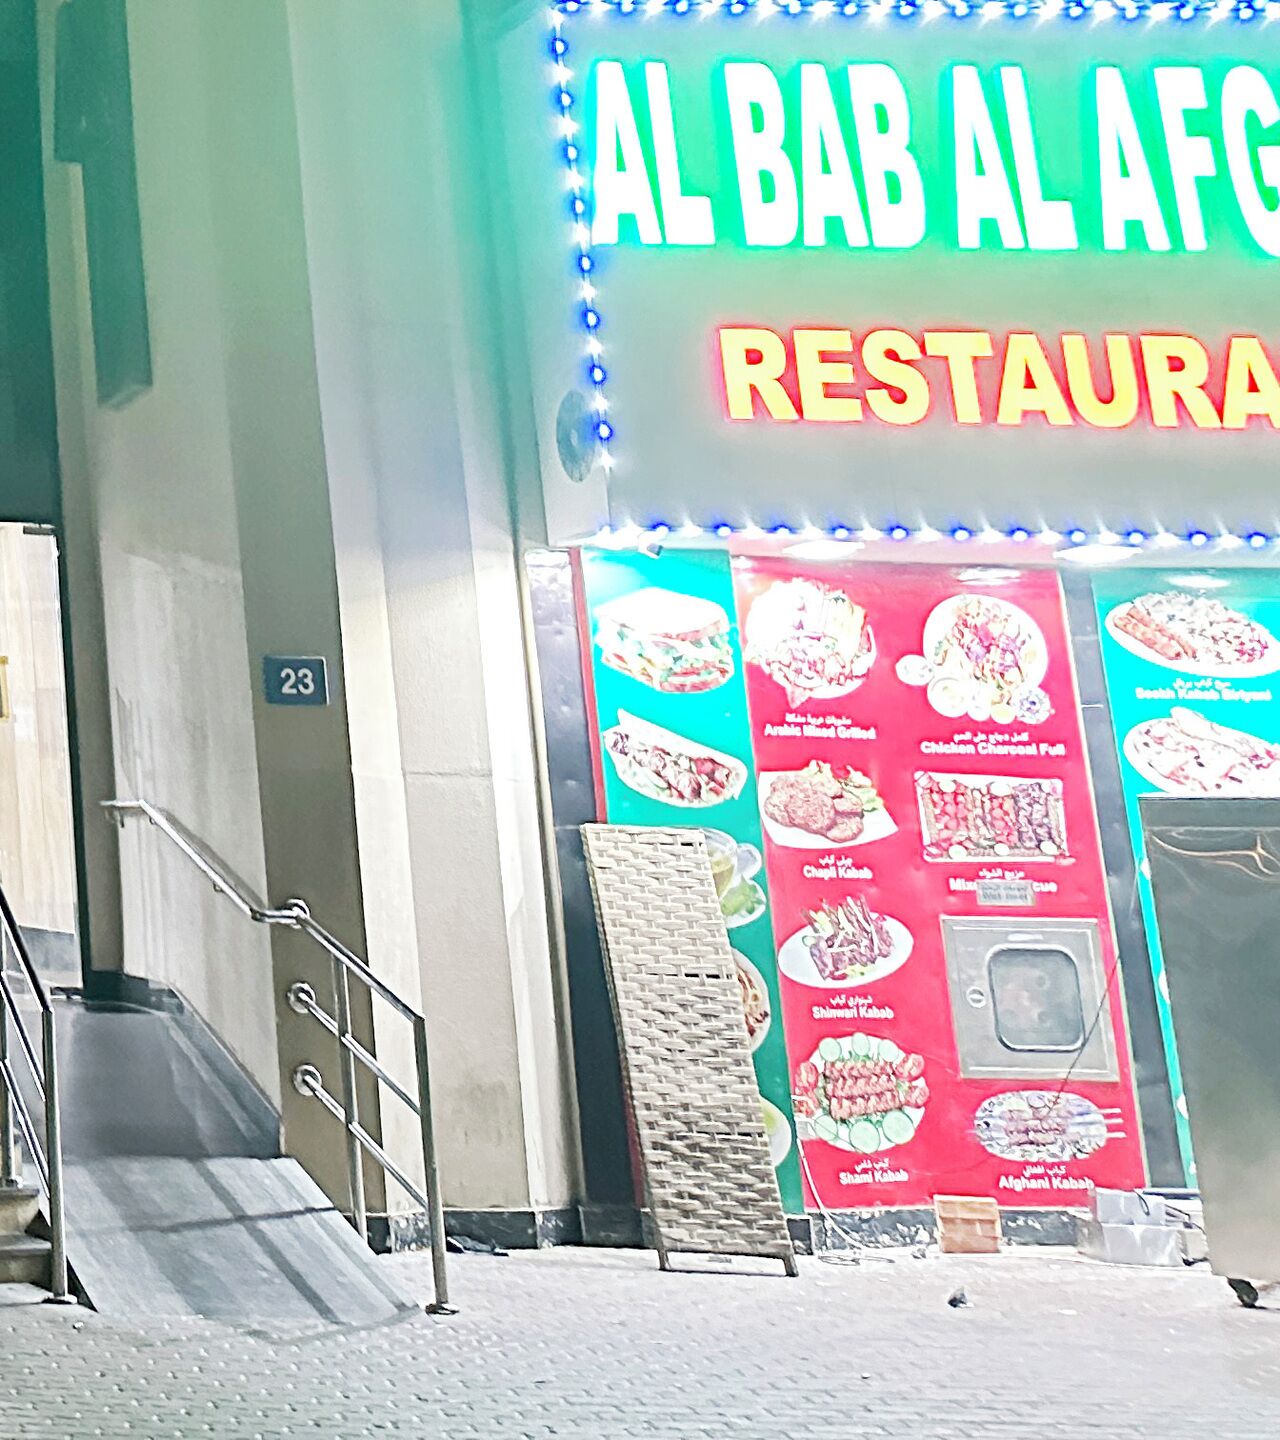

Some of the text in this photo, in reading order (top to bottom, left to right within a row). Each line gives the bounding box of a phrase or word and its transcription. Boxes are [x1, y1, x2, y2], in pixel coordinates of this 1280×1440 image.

[591, 60, 1280, 257] AL BAB AL AFG
[719, 327, 1280, 430] RESTAURA
[281, 667, 315, 695] 23
[764, 723, 802, 737] Arabic
[837, 725, 877, 740] Grilled
[920, 740, 1066, 756] Chicken Charcoal Full
[803, 865, 874, 880] Chapli Kabab
[811, 1006, 894, 1019] Shinwari Kabab
[839, 1168, 909, 1185] Shami Kabab
[999, 1175, 1095, 1191] Afghani Kabab
